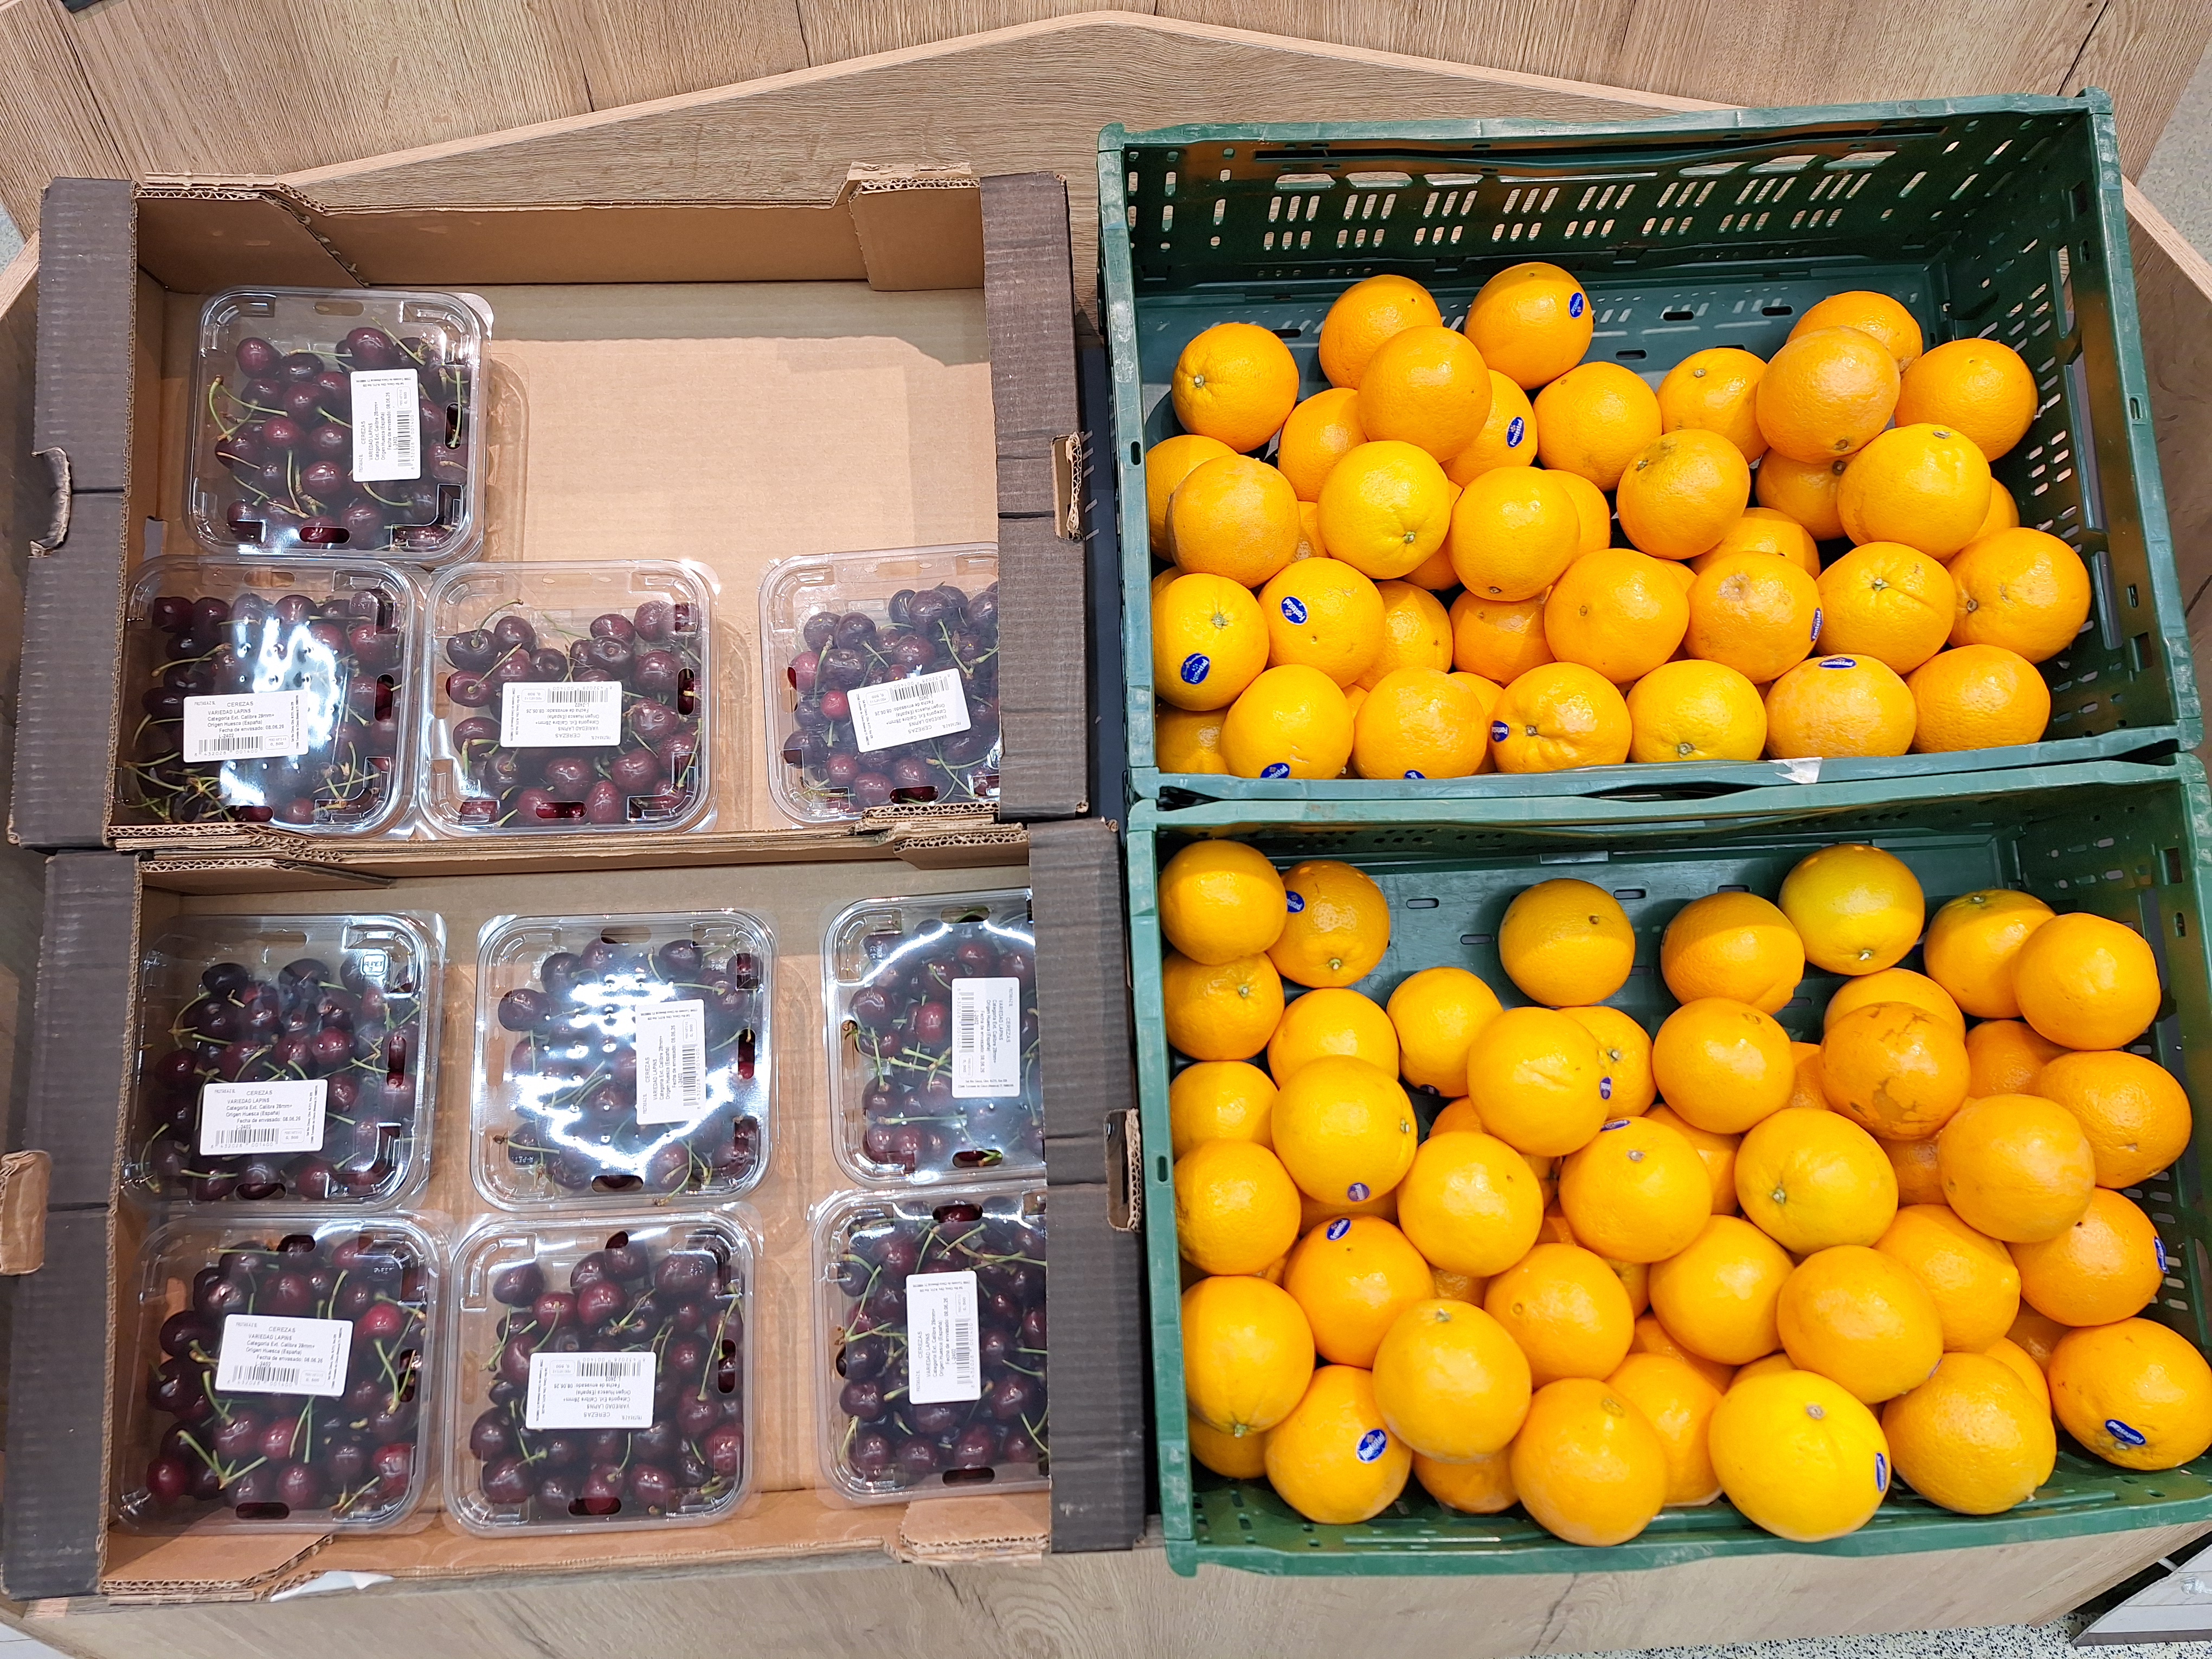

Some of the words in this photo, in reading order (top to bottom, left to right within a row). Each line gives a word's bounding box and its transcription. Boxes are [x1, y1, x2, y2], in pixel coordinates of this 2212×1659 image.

[1510, 419, 1523, 446] Fontestad
[1283, 599, 1306, 621] Fontestad
[1812, 611, 1821, 639] Fontestad
[1190, 659, 1209, 683] Fontestad
[908, 725, 933, 734] CEREZAS
[925, 715, 947, 723] VARIEDAD
[1359, 1432, 1386, 1461] Fontestad
